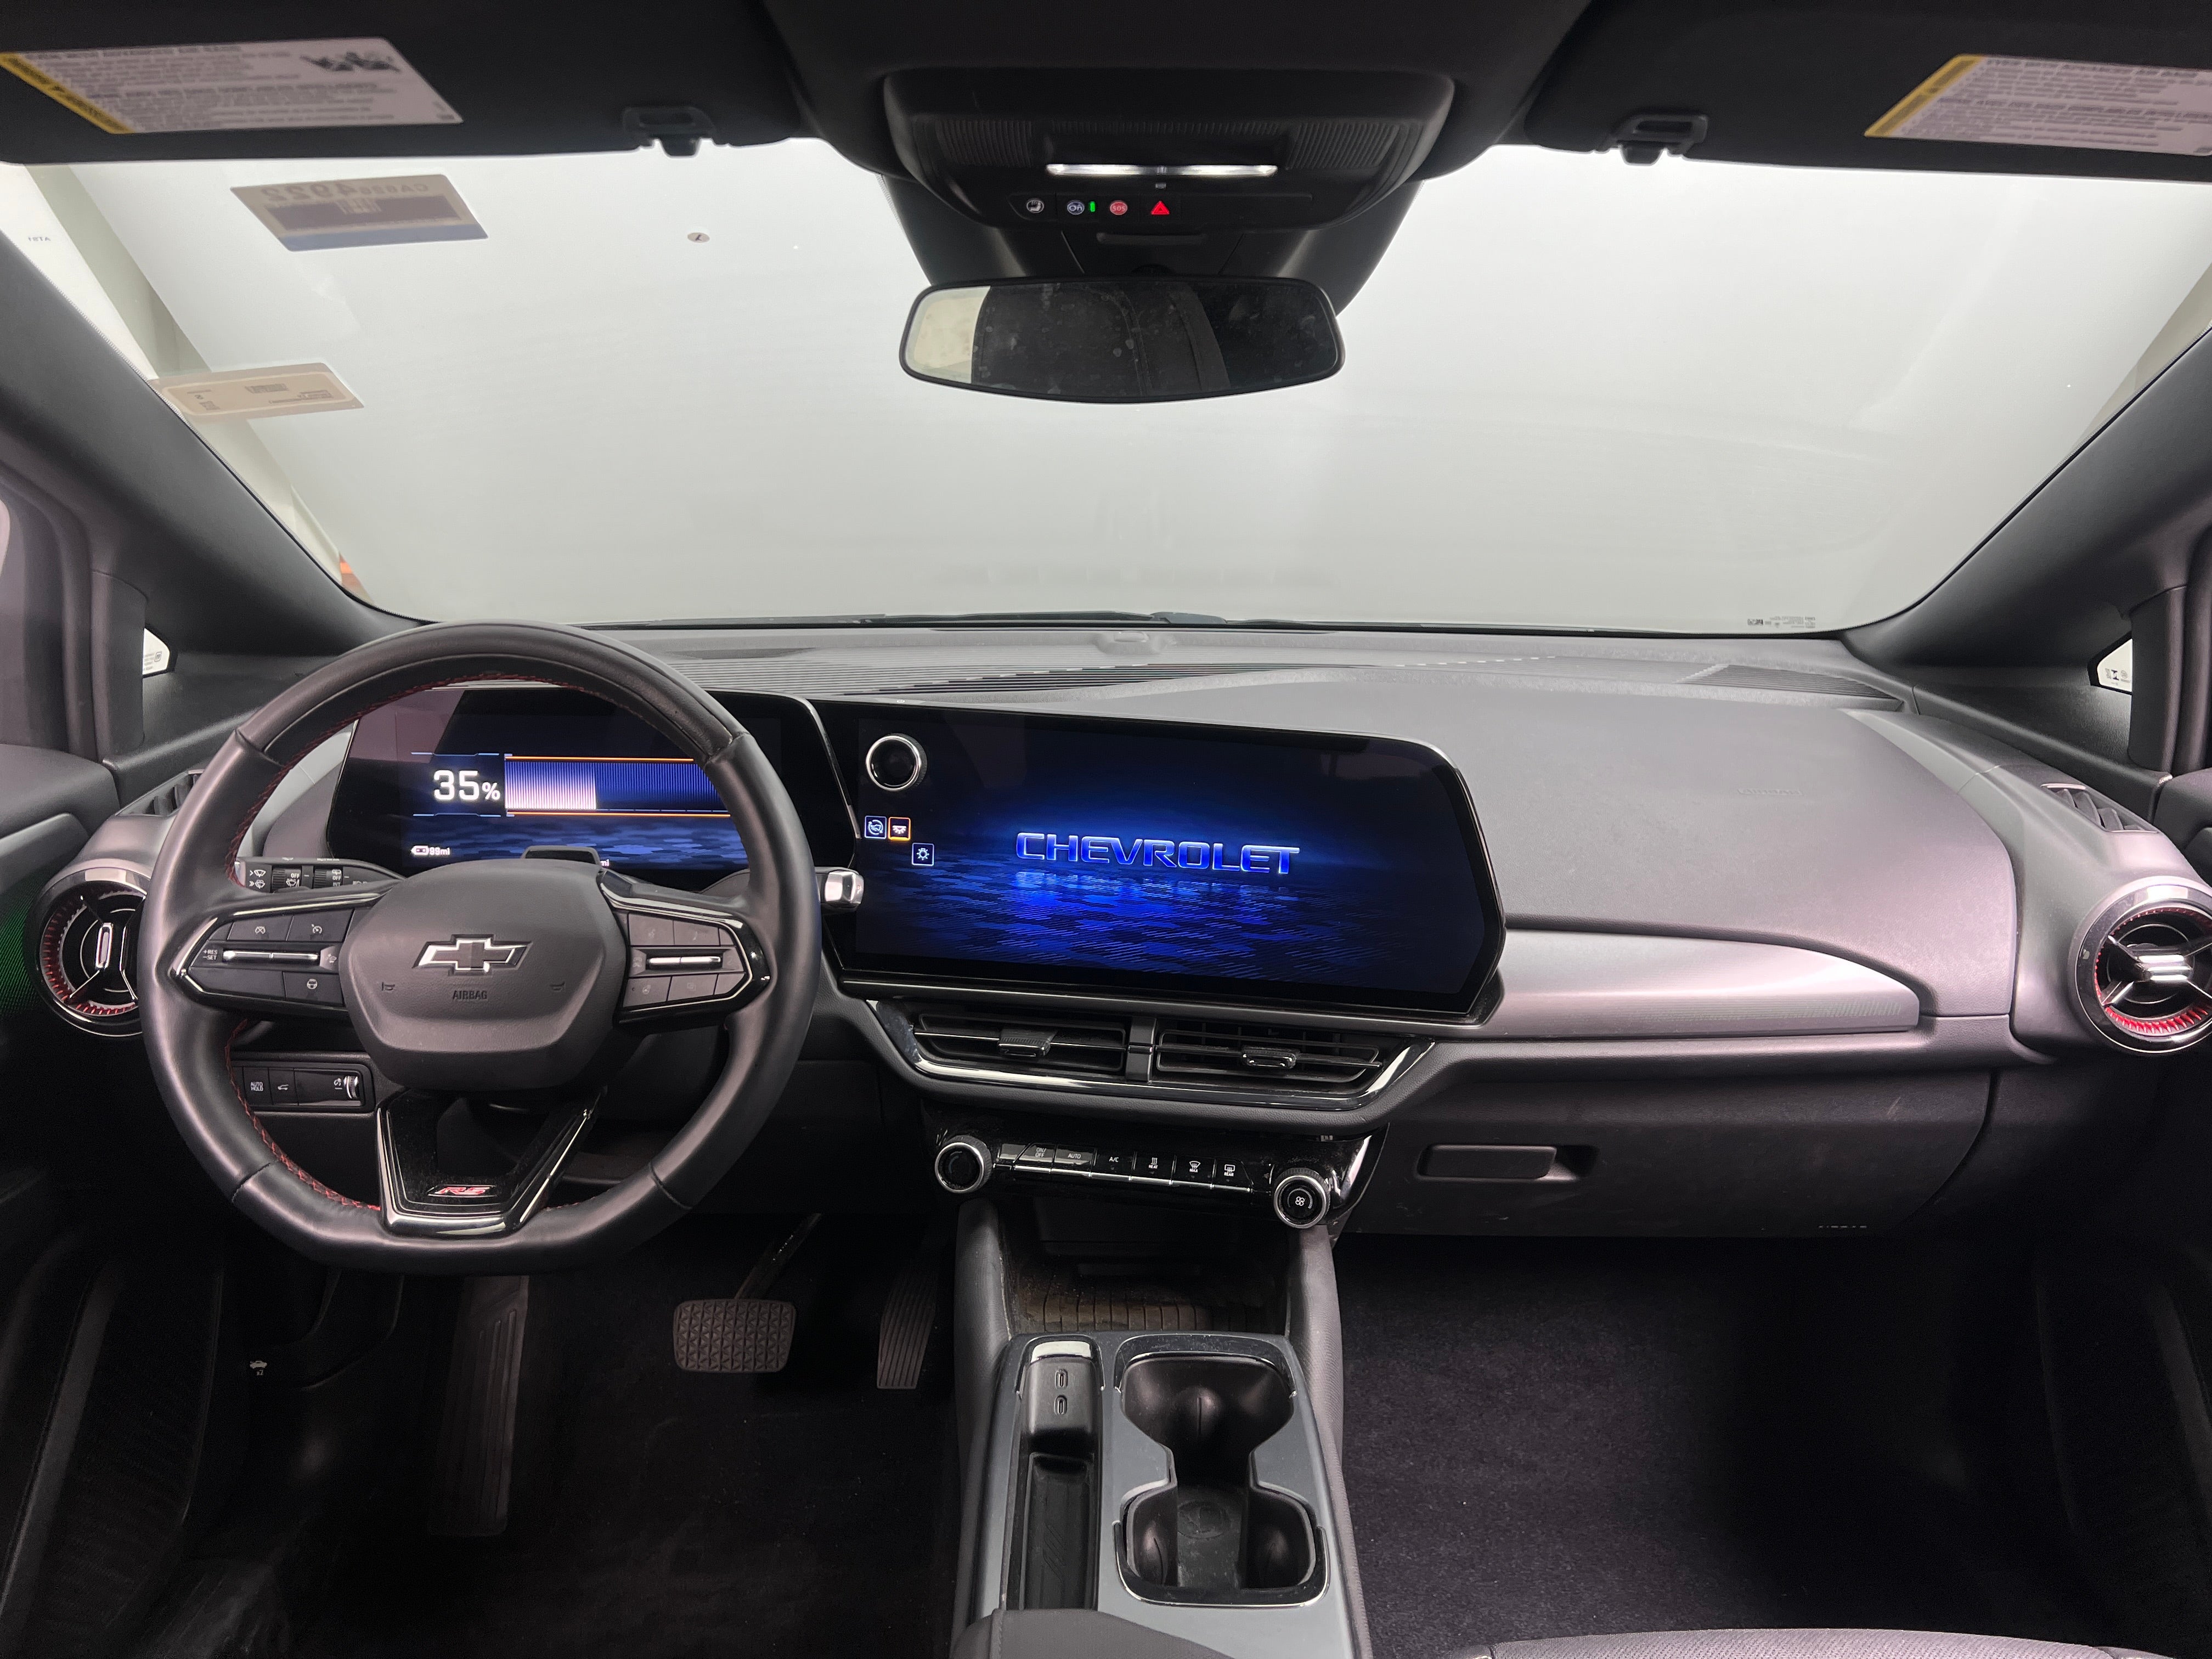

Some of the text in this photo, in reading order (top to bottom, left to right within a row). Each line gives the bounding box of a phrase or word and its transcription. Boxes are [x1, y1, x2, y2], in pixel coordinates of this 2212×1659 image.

[432, 769, 501, 801] 35%
[1015, 832, 1301, 874] CHEVROLET
[453, 990, 488, 1000] AIRBAG
[434, 1187, 490, 1195] RS
